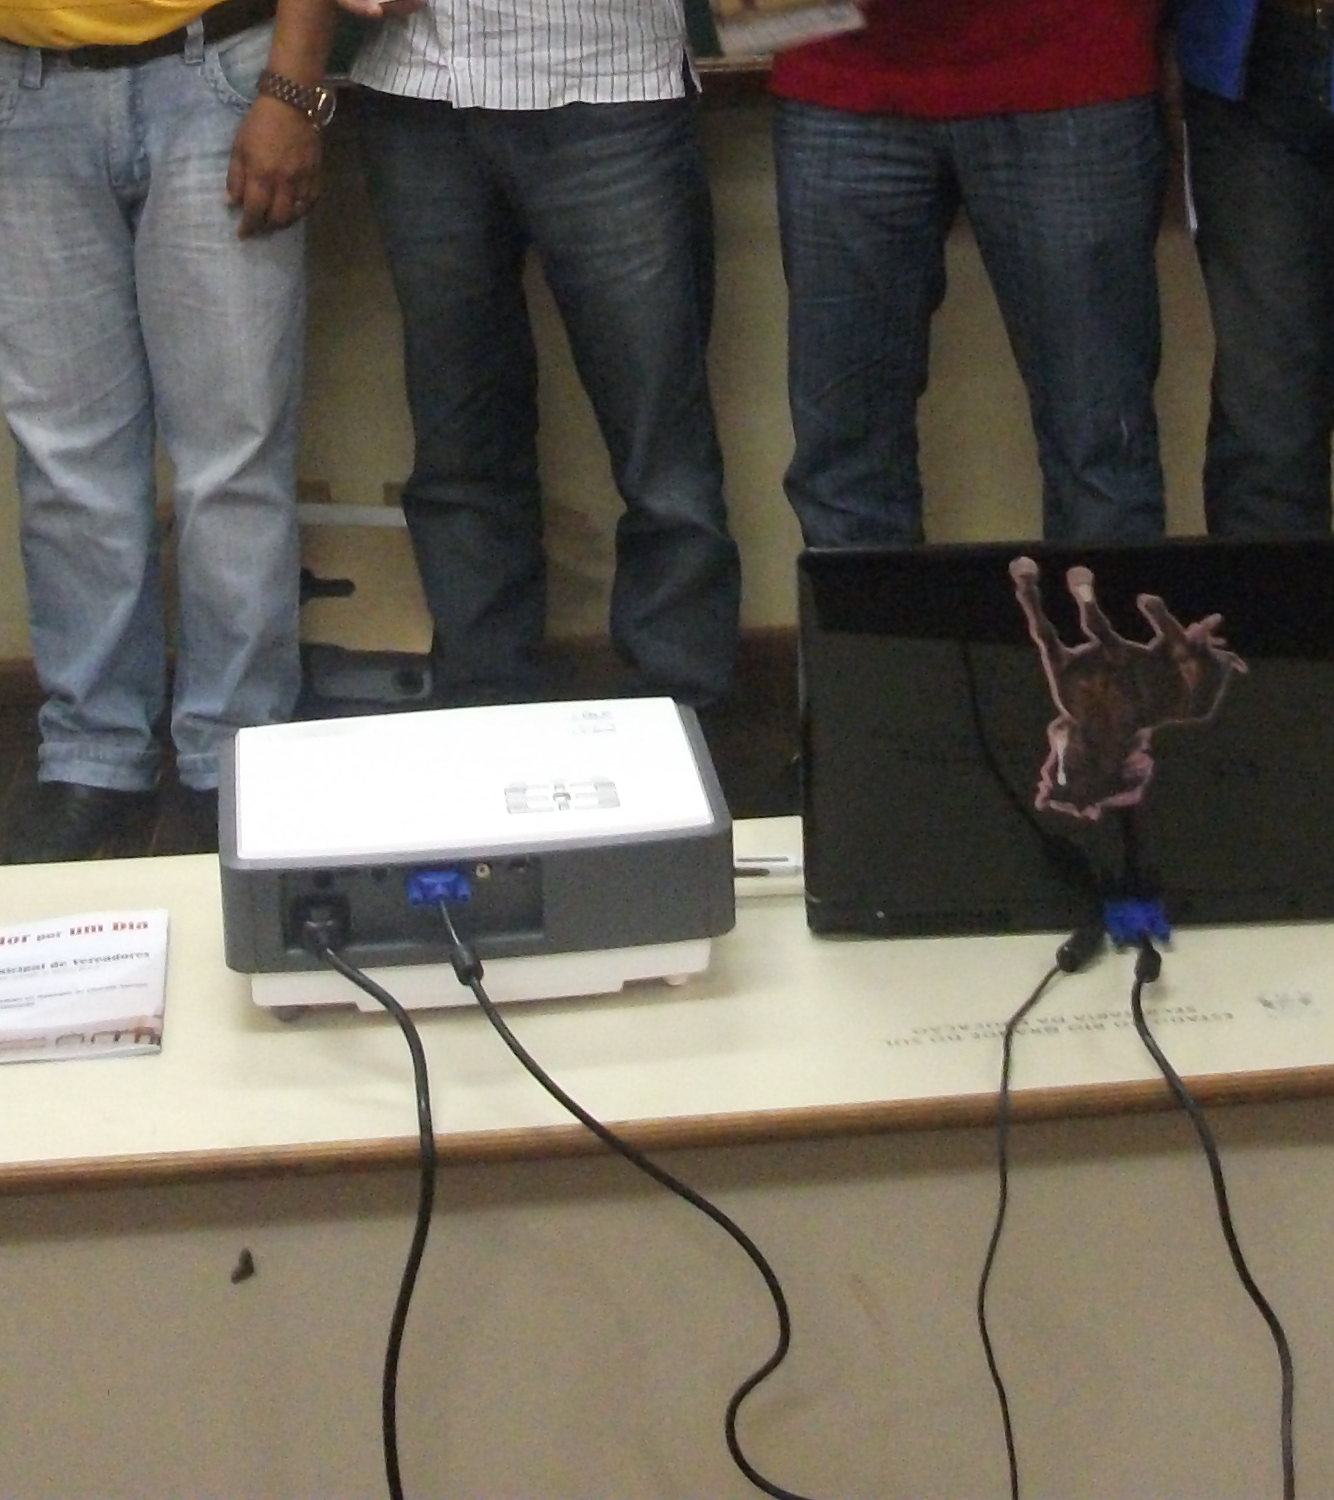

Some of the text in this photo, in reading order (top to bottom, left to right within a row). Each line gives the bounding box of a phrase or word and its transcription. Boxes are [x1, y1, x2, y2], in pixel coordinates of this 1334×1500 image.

[36, 930, 63, 943] por
[68, 923, 105, 937] um
[111, 920, 150, 933] Dia
